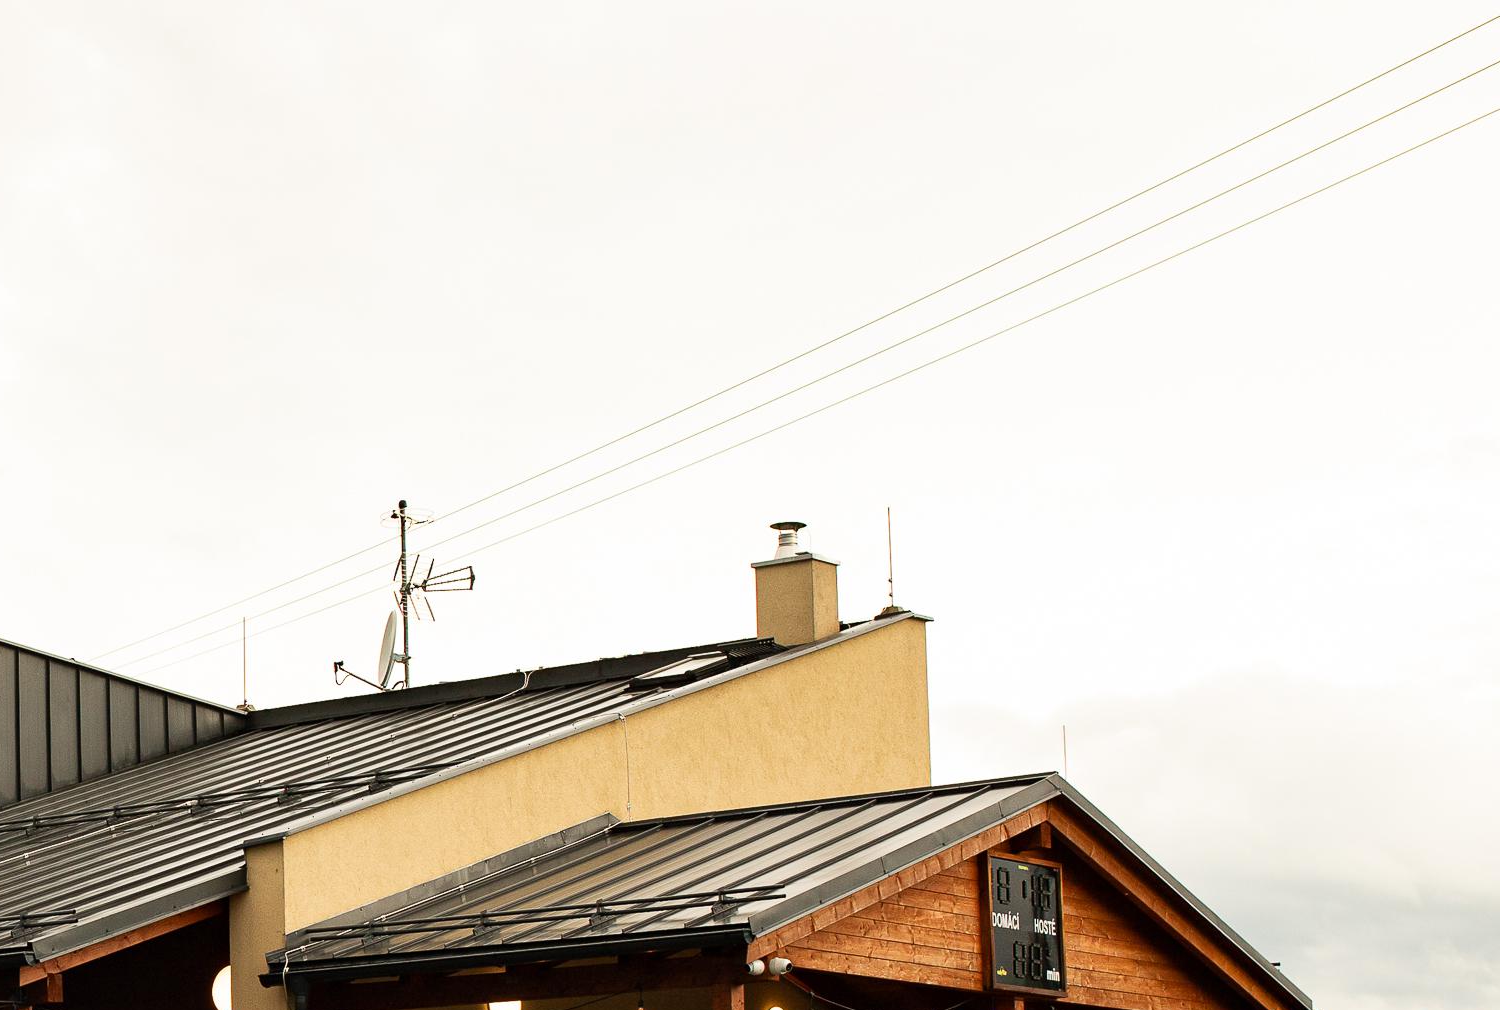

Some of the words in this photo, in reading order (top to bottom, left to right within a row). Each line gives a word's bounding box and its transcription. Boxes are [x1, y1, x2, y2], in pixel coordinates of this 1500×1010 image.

[992, 911, 1020, 930] DOMÁCÍ
[1034, 918, 1057, 936] HOSTÉ
[1046, 968, 1060, 982] min
